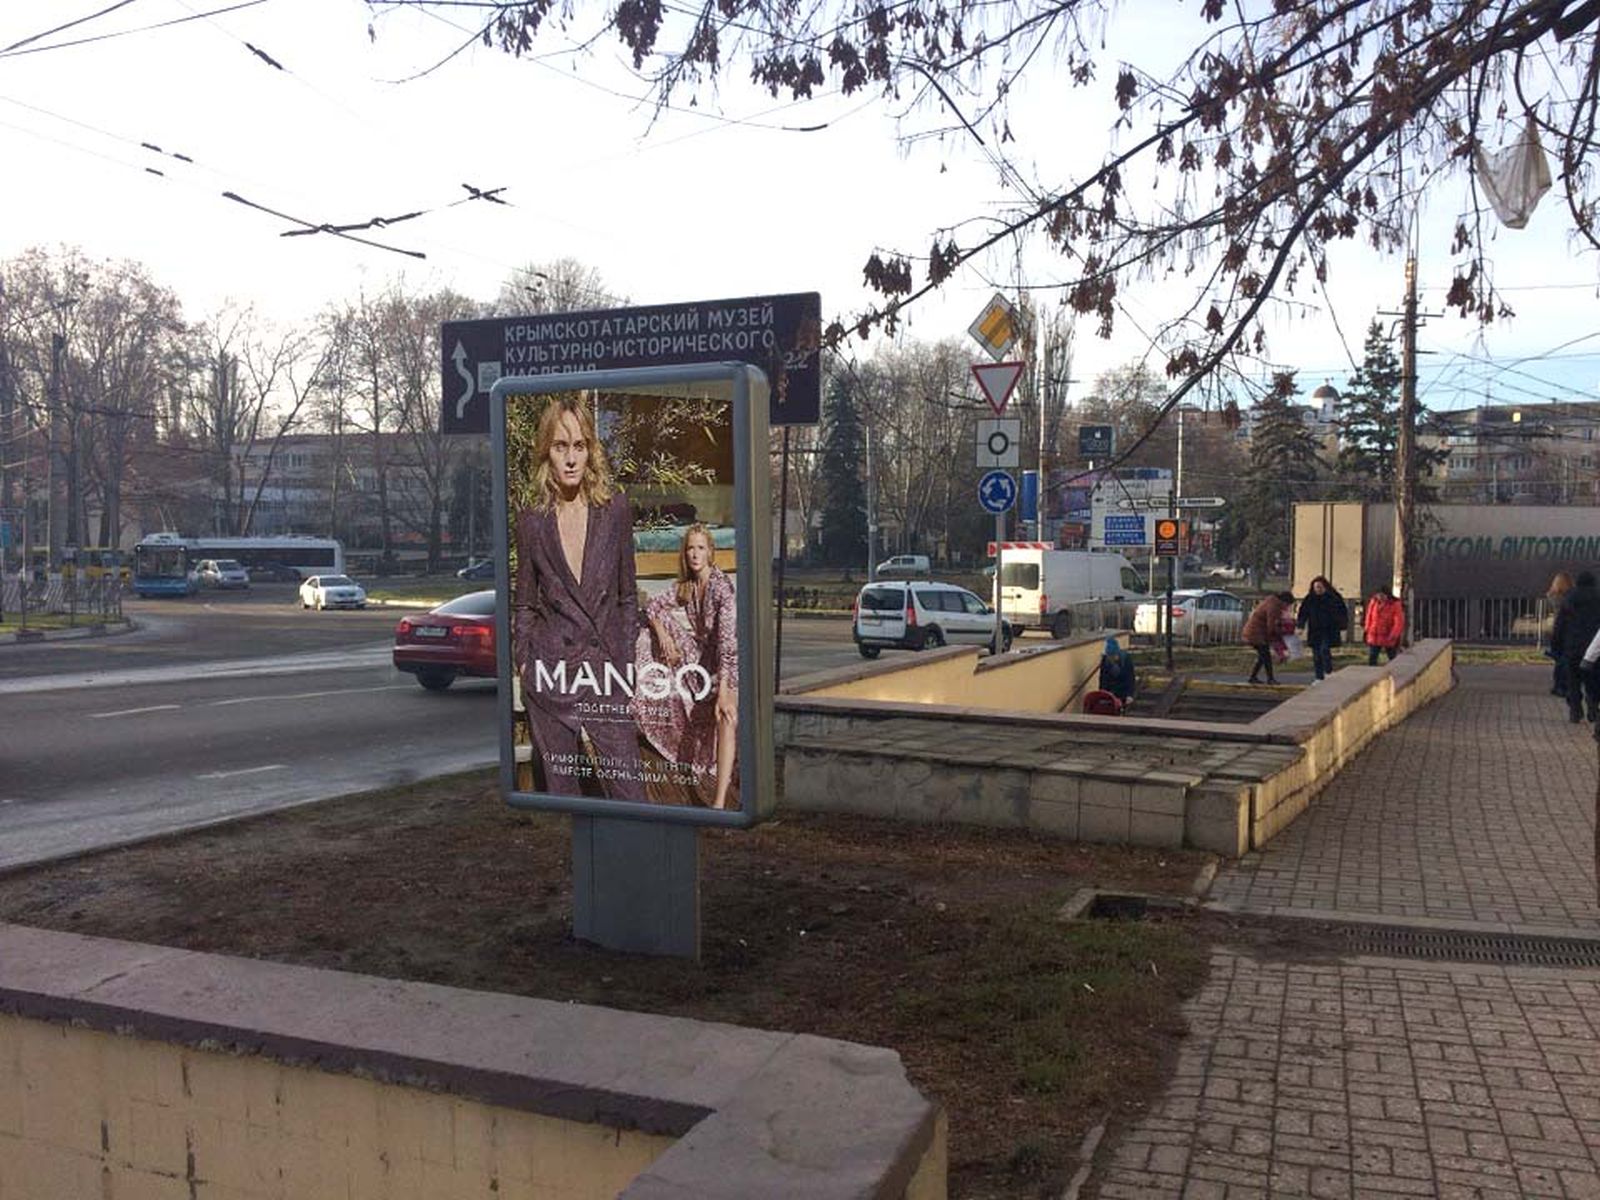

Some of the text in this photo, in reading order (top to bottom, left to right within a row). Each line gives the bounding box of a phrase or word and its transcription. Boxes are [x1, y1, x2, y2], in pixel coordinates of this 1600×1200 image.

[504, 303, 774, 342] КРЫМСКОТАТАРСКИЙ МУЗЕЙ
[505, 329, 775, 364] КУЛЬТУРНО-ИСТОРИЧЕСКОГО
[535, 659, 711, 701] MANGO
